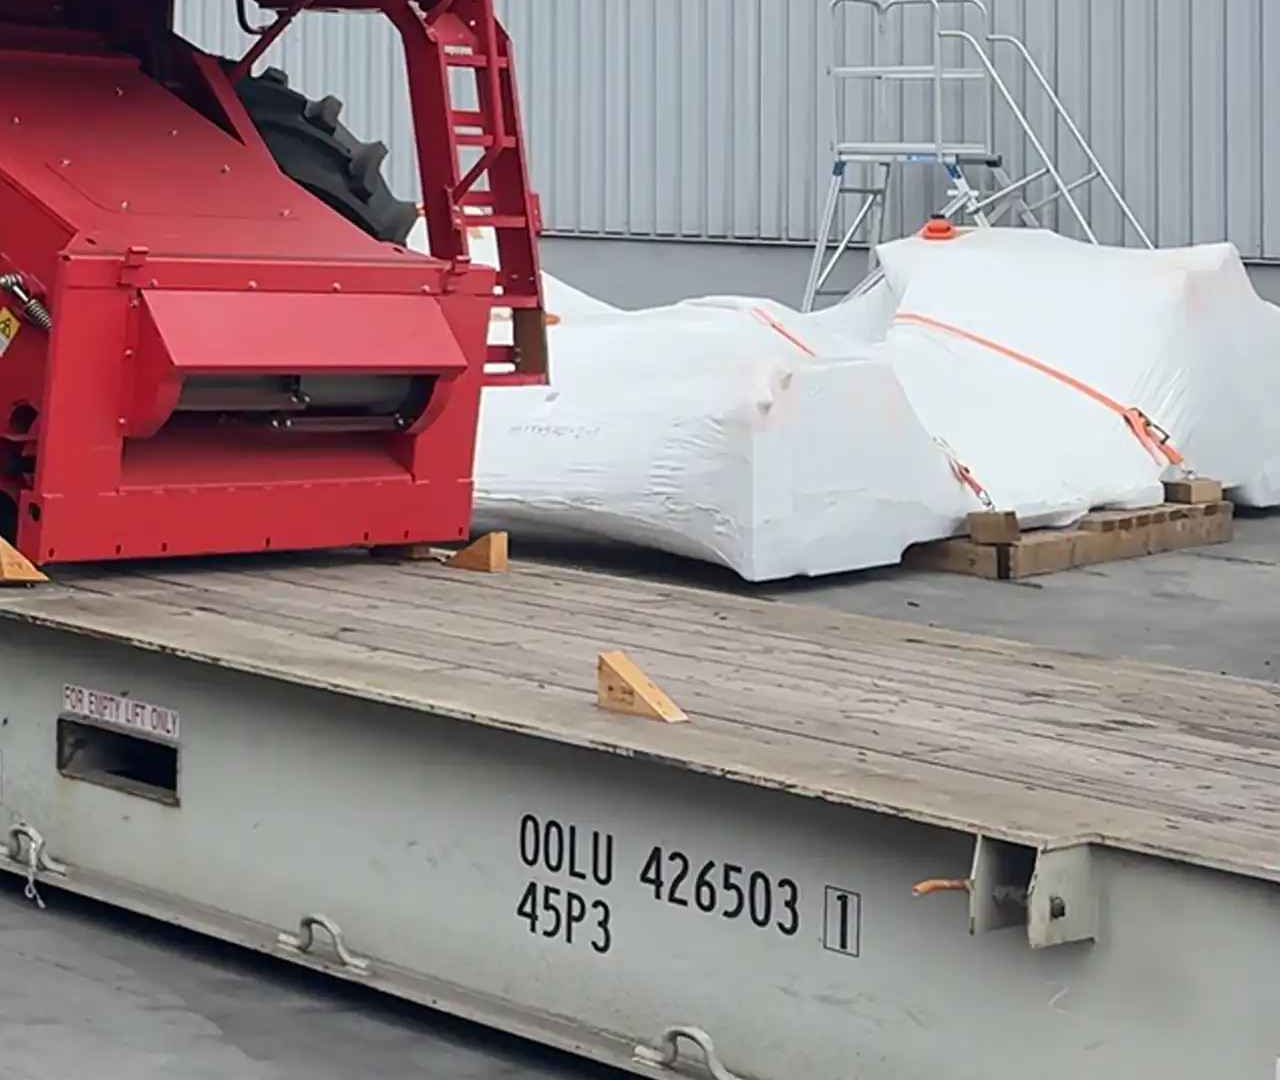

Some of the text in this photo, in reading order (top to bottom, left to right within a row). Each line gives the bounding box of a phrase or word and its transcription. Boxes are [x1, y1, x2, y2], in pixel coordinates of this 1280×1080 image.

[64, 685, 178, 736] FOR EMPTY LIFT ONLY
[517, 880, 612, 954] 45P3
[640, 845, 800, 937] 426503
